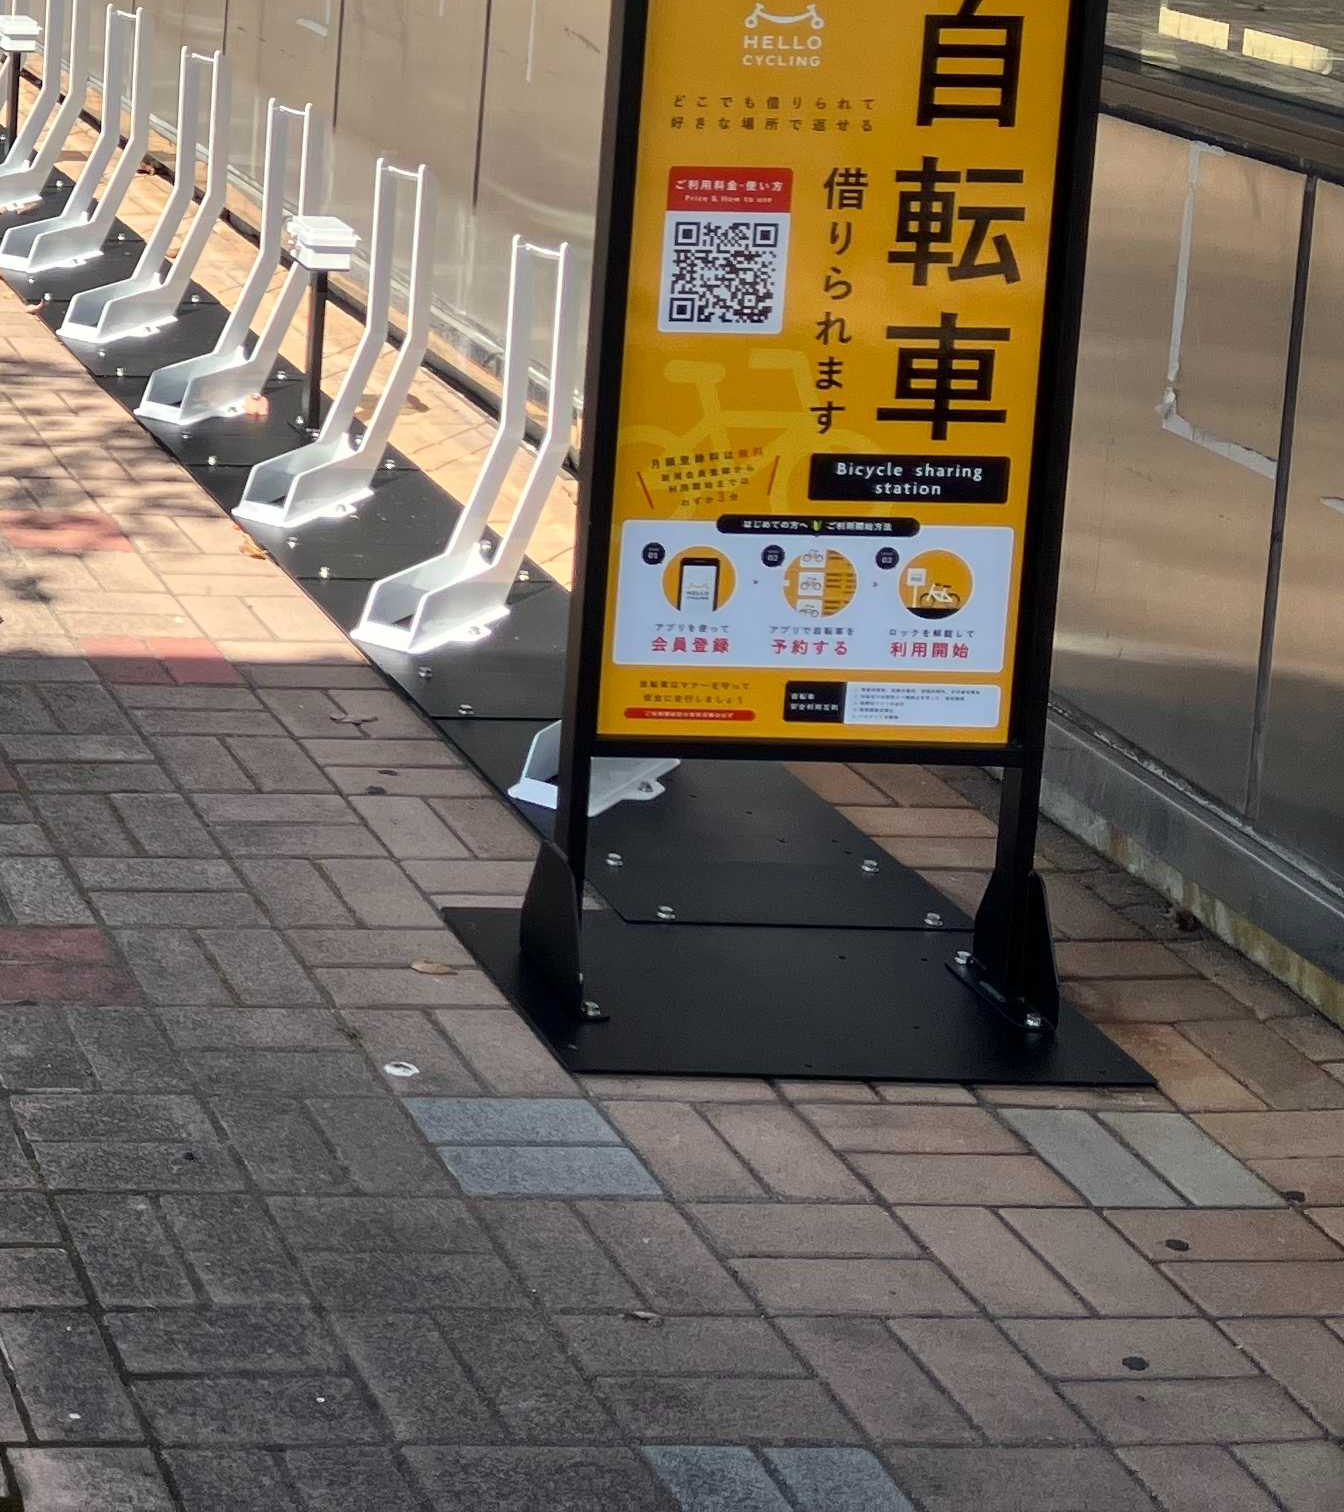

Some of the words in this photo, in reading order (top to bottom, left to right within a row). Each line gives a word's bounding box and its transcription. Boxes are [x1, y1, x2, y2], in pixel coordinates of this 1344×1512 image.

[743, 35, 822, 50] HELLO
[742, 54, 821, 67] CYCLING
[673, 95, 875, 110] どこでも借りられて
[671, 117, 873, 132] 好きな場所で返せる
[809, 166, 869, 434] 借りられます
[836, 462, 903, 479] Bicycle
[915, 463, 983, 482] sharing
[875, 482, 941, 496] station
[651, 636, 729, 653] 会員登録
[771, 639, 848, 655] 予約する
[890, 642, 969, 659] 利用開始
